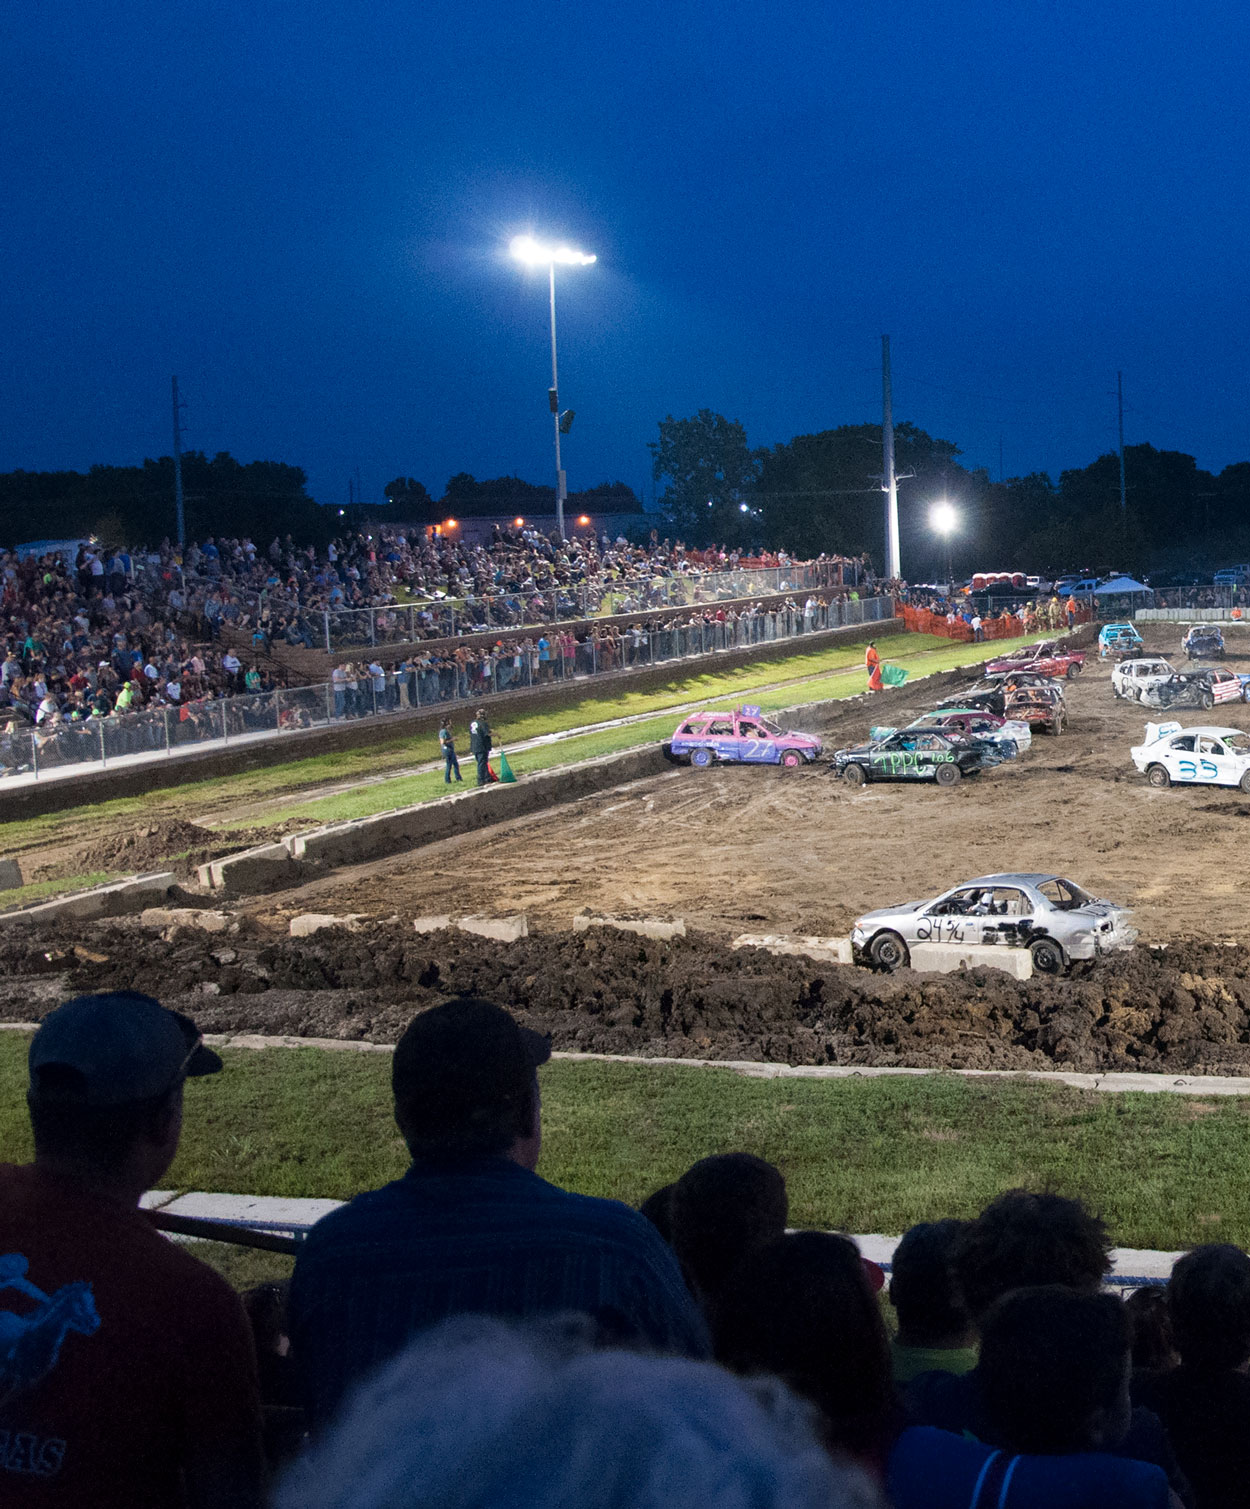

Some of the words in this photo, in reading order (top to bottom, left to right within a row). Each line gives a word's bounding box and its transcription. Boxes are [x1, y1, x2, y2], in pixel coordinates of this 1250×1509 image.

[744, 739, 774, 758] 27
[931, 752, 955, 763] 106
[1179, 760, 1218, 779] 33
[916, 917, 942, 943] 24
